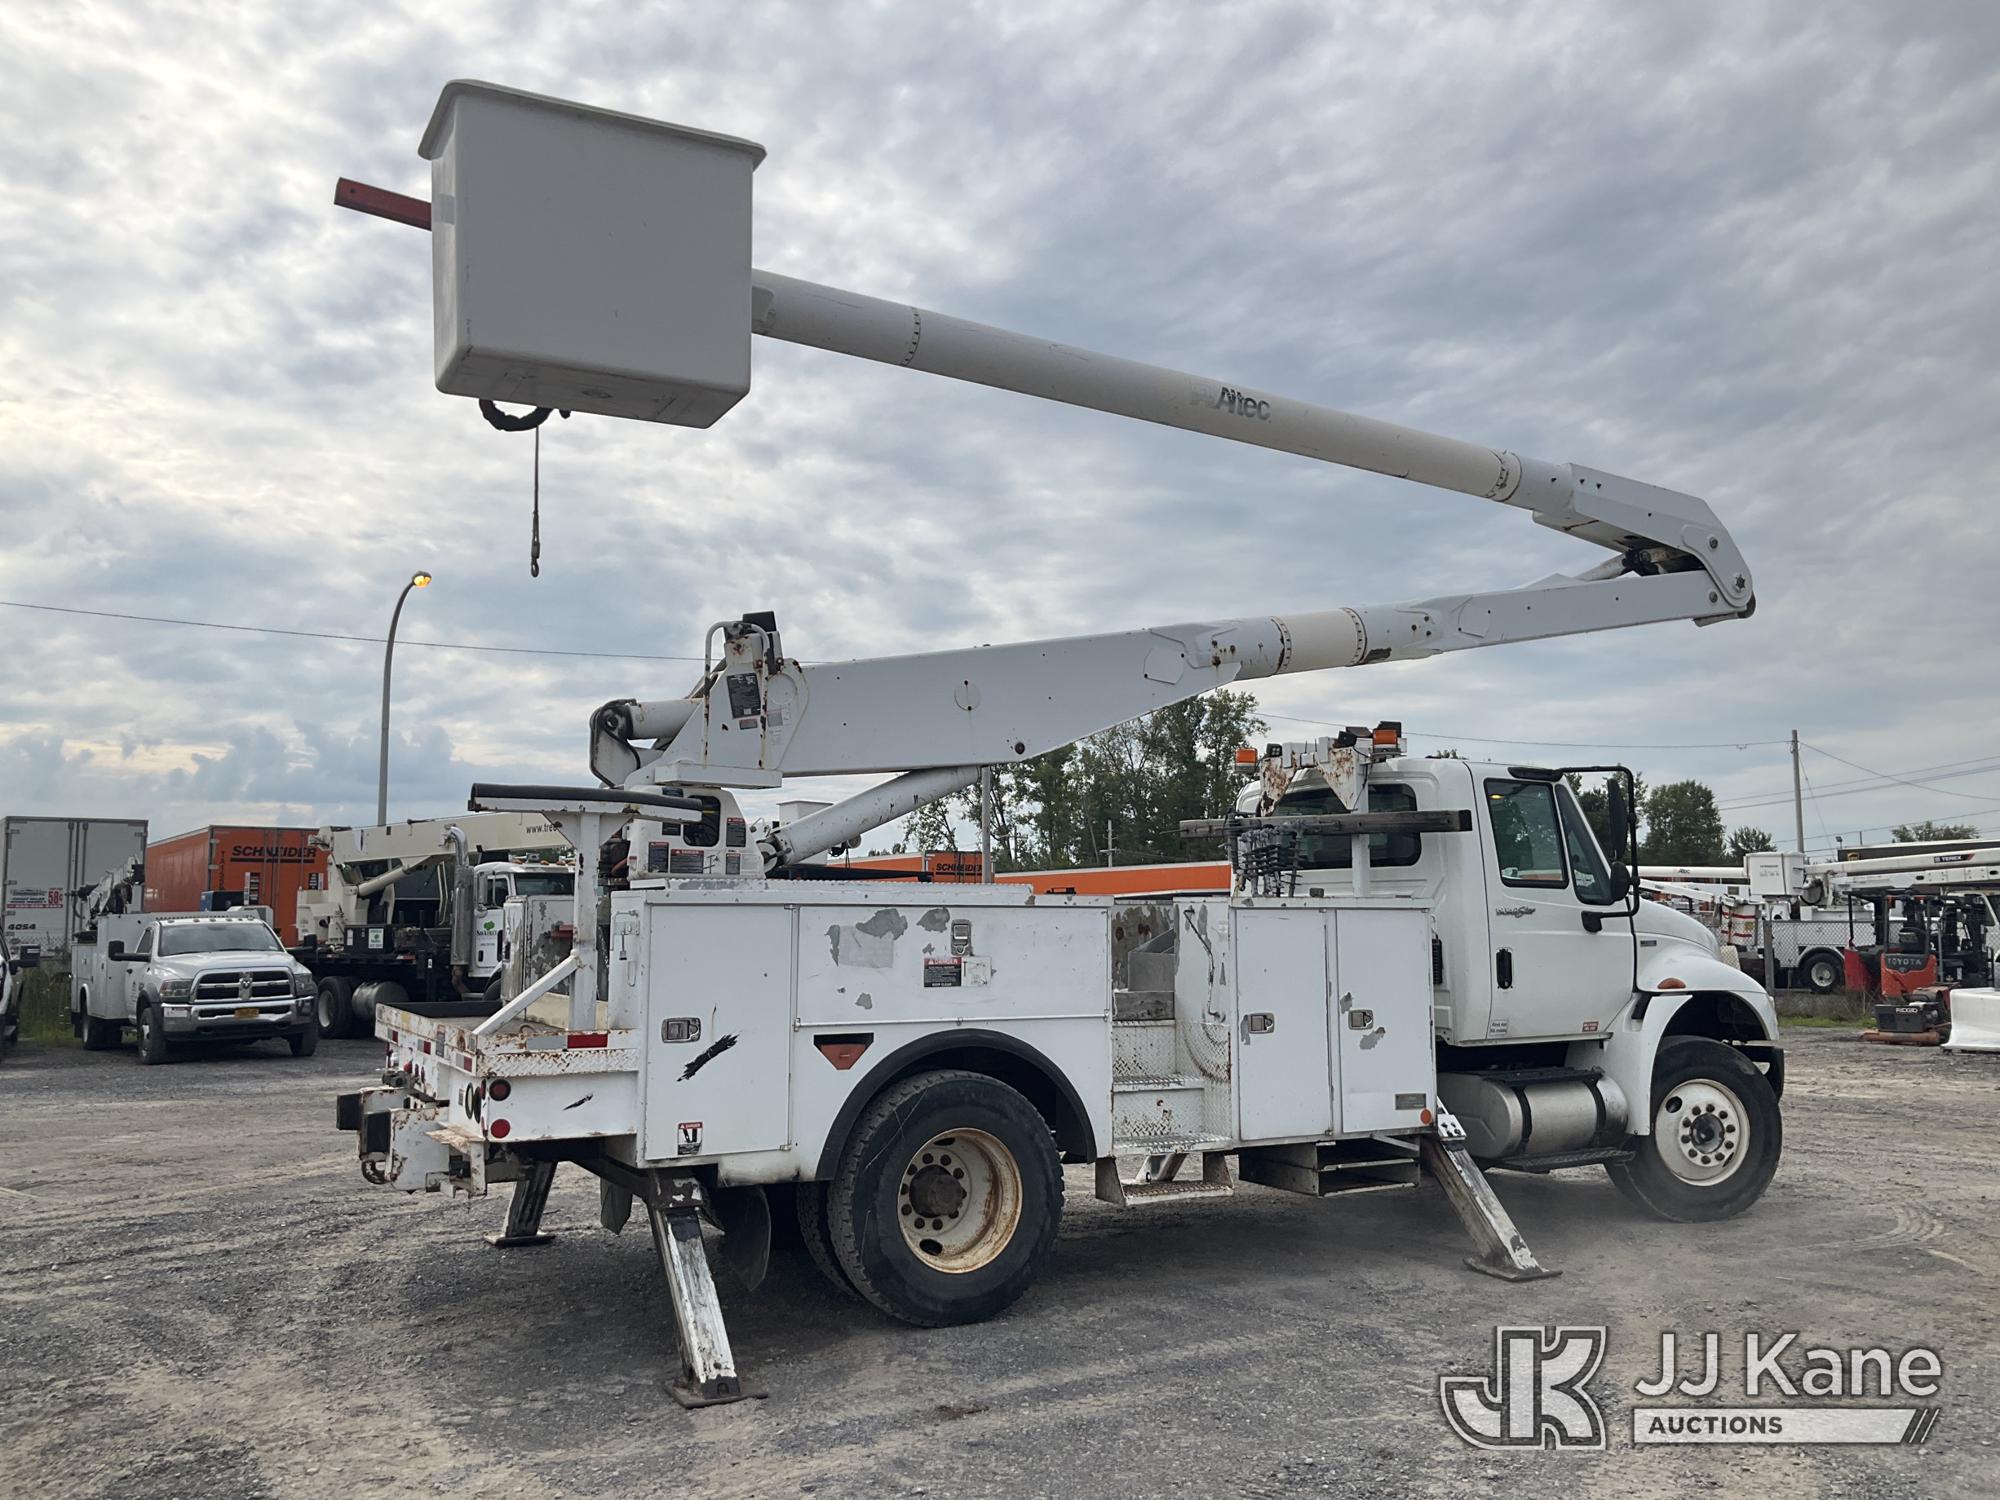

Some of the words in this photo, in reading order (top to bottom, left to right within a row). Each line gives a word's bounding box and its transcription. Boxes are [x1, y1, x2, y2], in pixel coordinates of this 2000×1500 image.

[1216, 386, 1272, 421] Altec
[232, 845, 317, 858] SCHNEIDER
[8, 923, 36, 931] 4054
[1887, 958, 1922, 966] TOYOTA
